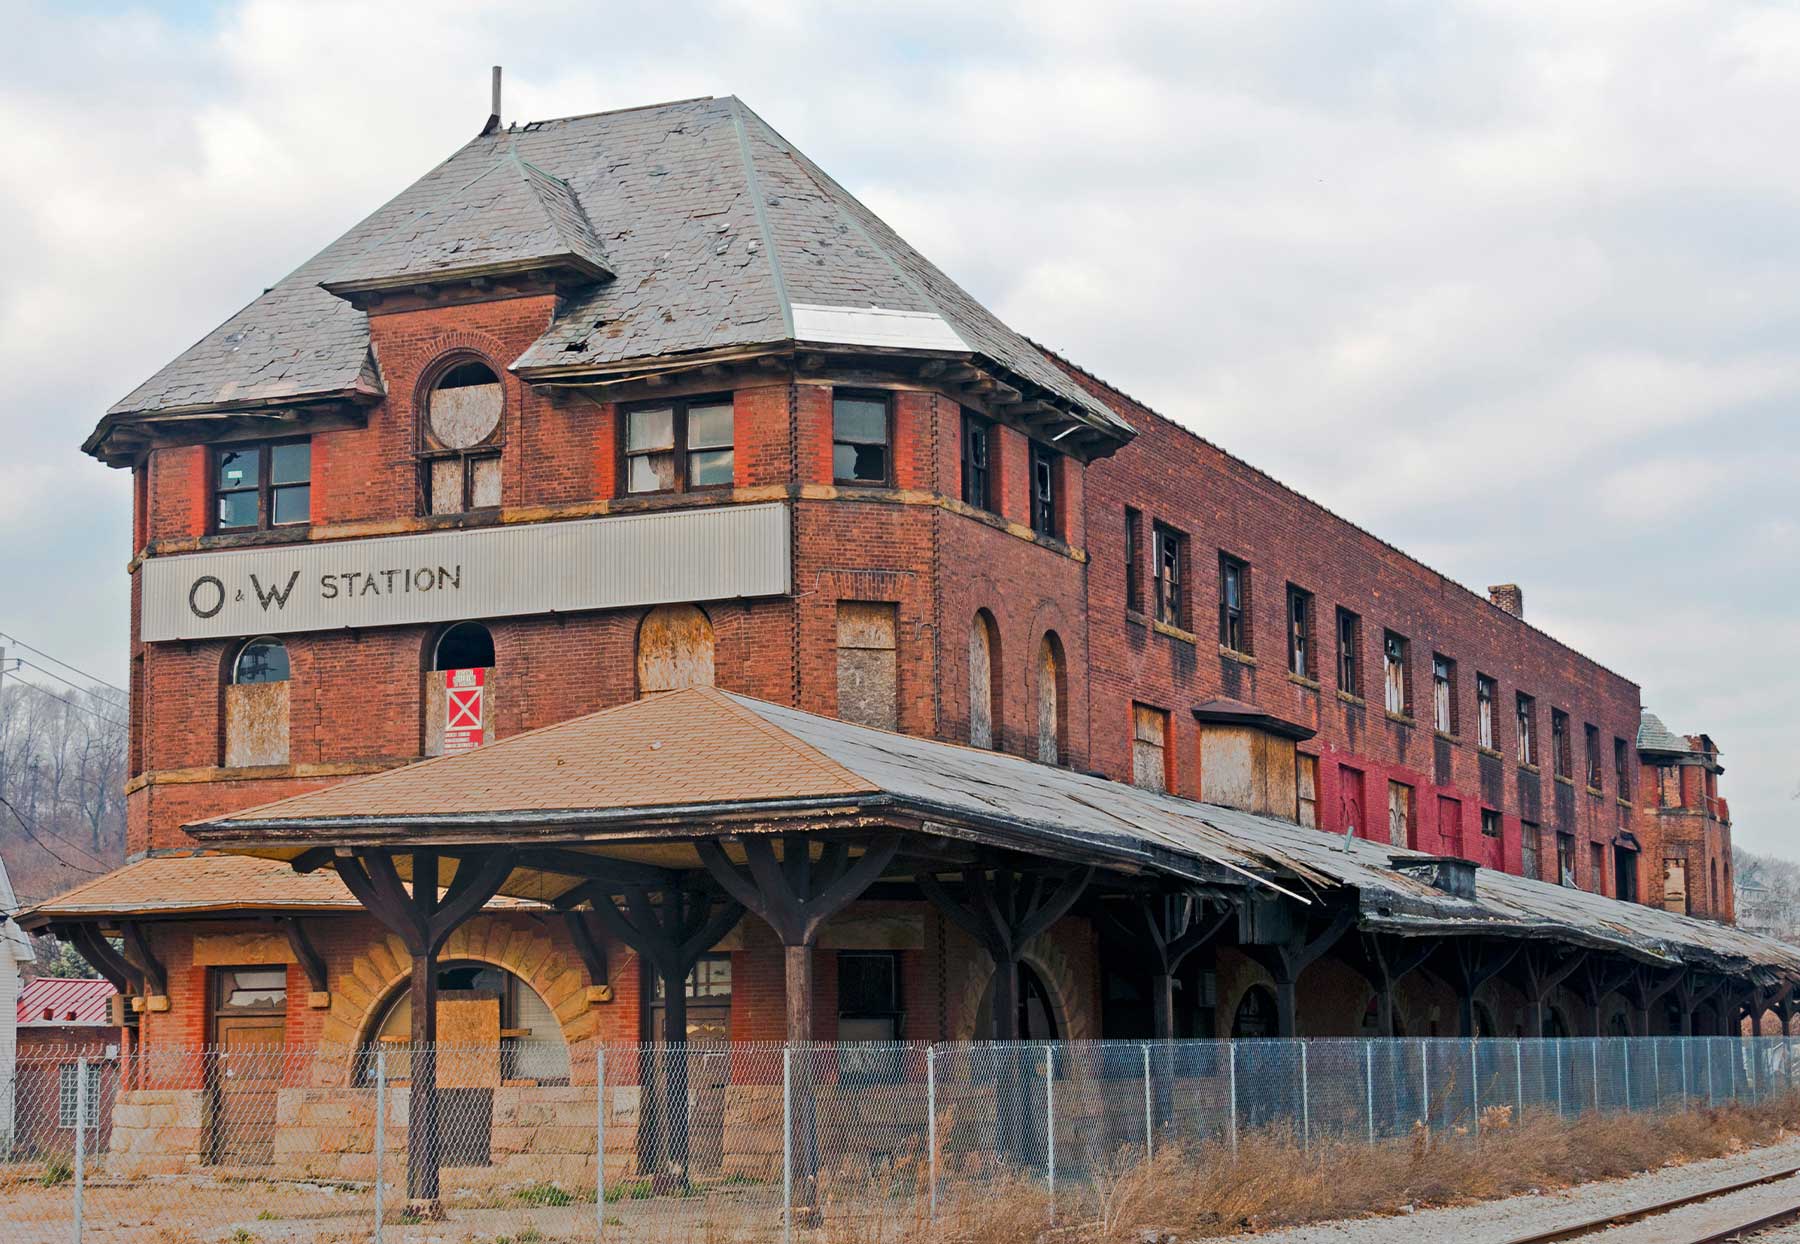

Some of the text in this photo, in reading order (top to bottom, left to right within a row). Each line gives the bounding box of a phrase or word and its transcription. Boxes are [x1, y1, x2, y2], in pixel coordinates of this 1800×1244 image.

[189, 565, 461, 618] O & W STATION
